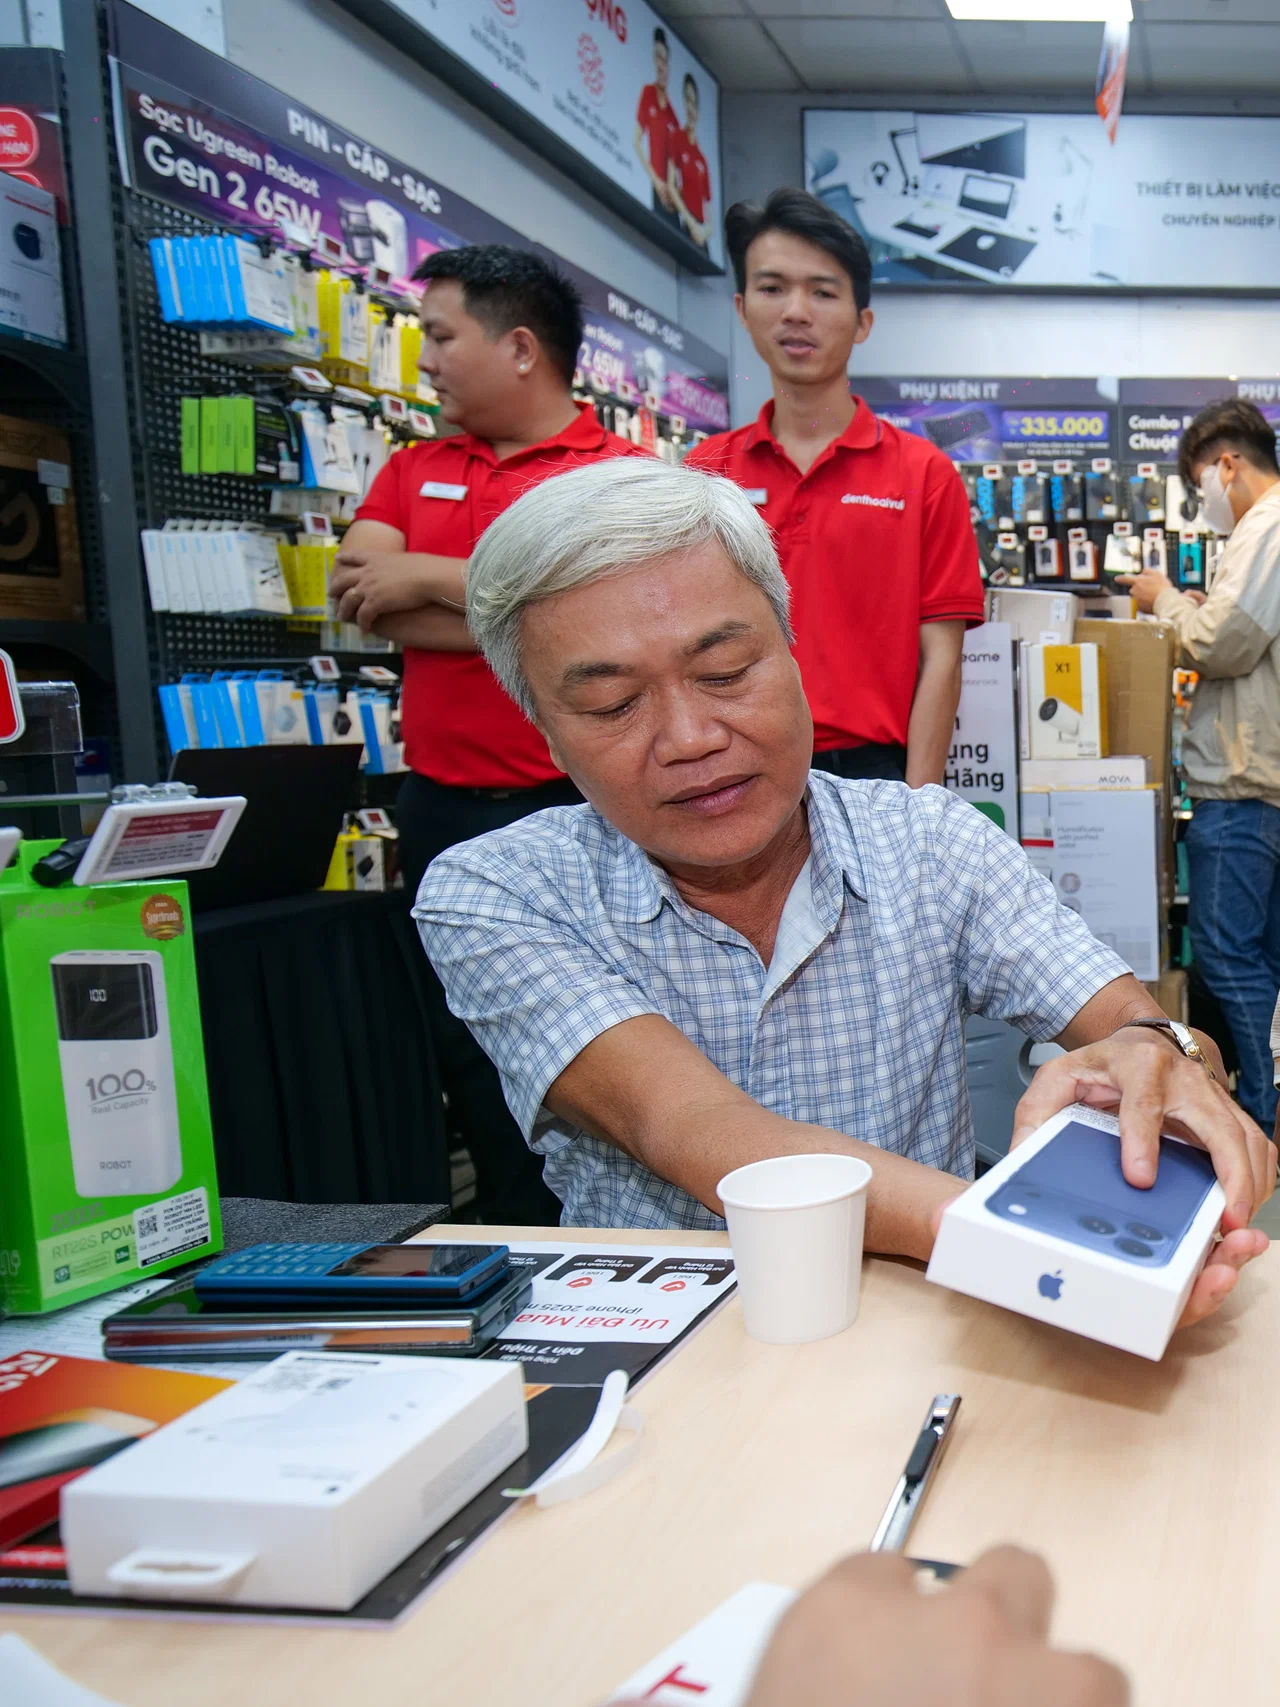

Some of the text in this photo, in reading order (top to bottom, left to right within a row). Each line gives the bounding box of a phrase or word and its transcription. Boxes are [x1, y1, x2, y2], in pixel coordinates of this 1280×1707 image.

[139, 93, 320, 198] Sạc Ugreen Robot
[287, 108, 442, 215] PIN CÁP SẠC
[144, 135, 322, 240] Gen 2 65W
[1136, 178, 1181, 197] THIẾT
[1186, 181, 1200, 199] BỊ
[1206, 179, 1240, 198] LÀM
[1162, 212, 1220, 227] CHUYÊN
[1223, 212, 1276, 230] NGHIỆP
[900, 380, 1000, 405] PHỤ KIỆN IT
[1237, 383, 1276, 403] PHỤ
[1020, 417, 1104, 437] 335.000
[1129, 414, 1180, 430] Combo
[1055, 662, 1071, 674] X1
[1099, 775, 1131, 784] MOVA
[16, 901, 95, 919] ROBOT
[146, 911, 179, 925] Superbrands
[89, 988, 107, 1002] 100
[86, 1068, 157, 1101] 100%
[92, 1097, 150, 1115] Real Capacity
[99, 1160, 132, 1170] ROBOT
[541, 1302, 643, 1315] iPhone 2025
[515, 1313, 670, 1331] Ưu Đãi Mua
[499, 1343, 584, 1355] Đến 7 Triệu
